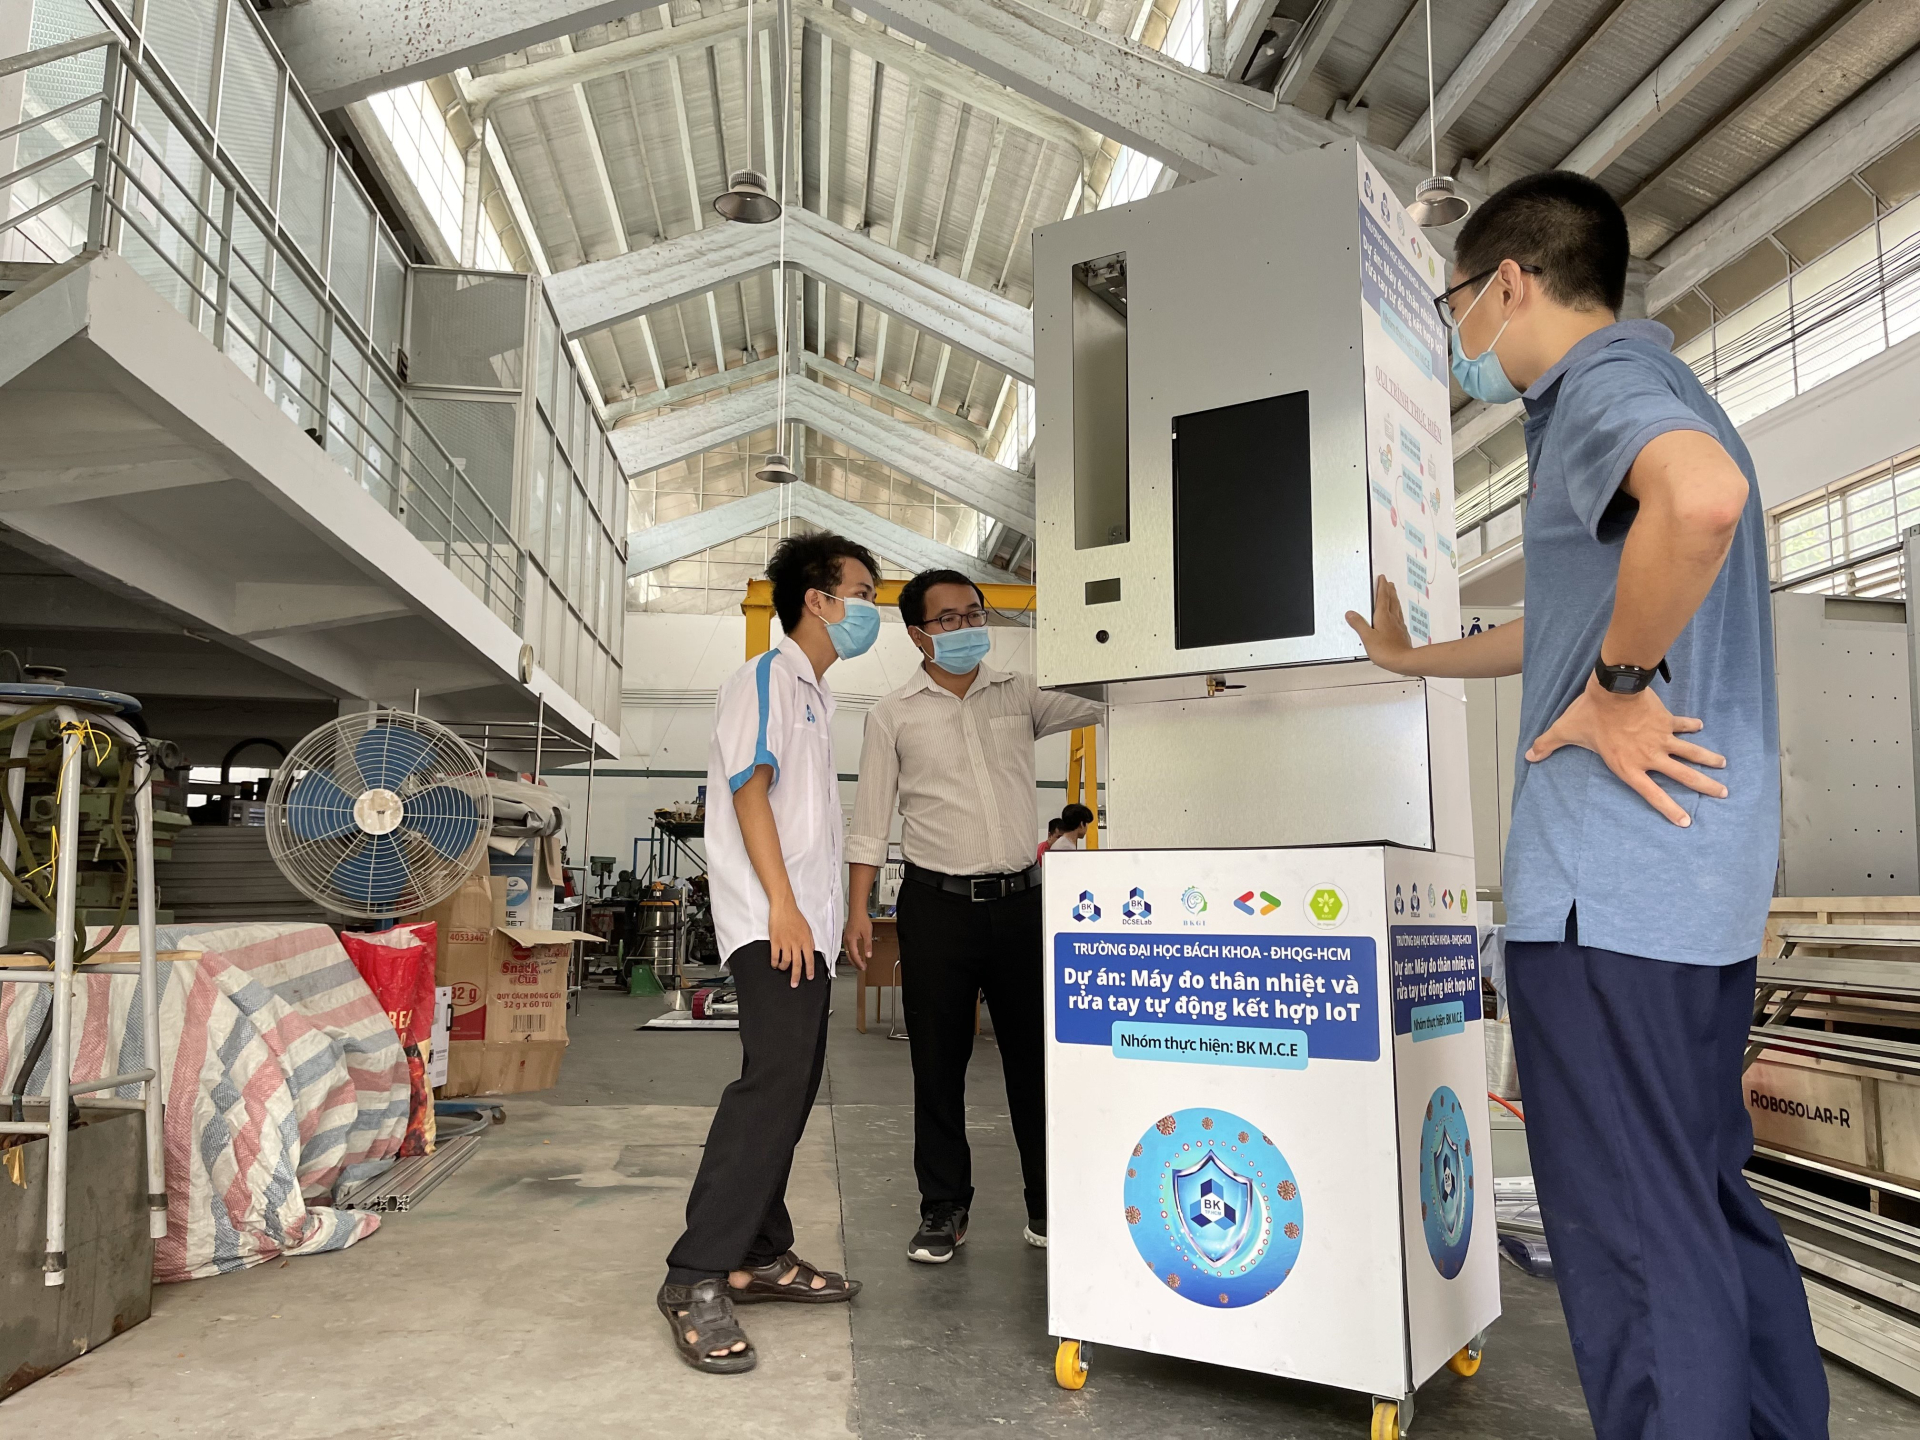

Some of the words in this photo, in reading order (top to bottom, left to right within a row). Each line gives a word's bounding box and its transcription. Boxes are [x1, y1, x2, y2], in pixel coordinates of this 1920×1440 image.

[1073, 940, 1127, 955] TRƯỜNG
[1129, 944, 1150, 959] ĐẠI
[1153, 944, 1181, 960] HỌC
[1183, 942, 1219, 958] BÁCH
[1222, 945, 1261, 959] KHOA
[1270, 946, 1351, 962] ĐHQG-HCM
[501, 960, 539, 974] Snack
[1394, 960, 1403, 980] Dự
[1404, 958, 1414, 975] án:
[1415, 957, 1428, 978] Máy
[1429, 957, 1437, 973] đo
[1437, 956, 1451, 972] thân
[1452, 955, 1467, 975] nhiệt
[1467, 955, 1475, 970] và
[1064, 967, 1093, 990] Dự
[1096, 967, 1126, 987] án:
[1131, 969, 1174, 993] Máy
[1178, 970, 1204, 989] đo
[1209, 970, 1260, 991] thân
[1266, 973, 1326, 998] nhiệt
[1331, 974, 1359, 994] và
[1397, 981, 1407, 1000] rửa
[1409, 984, 1418, 1002] tay
[1420, 982, 1427, 1001] tự
[1429, 979, 1443, 999] động
[1444, 977, 1454, 994] kết
[1455, 977, 1466, 996] hợp
[503, 1001, 514, 1009] 32
[1068, 989, 1103, 1010] rửa
[1107, 994, 1141, 1017] tay
[1145, 996, 1171, 1018] tự
[1174, 995, 1227, 1021] động
[1232, 997, 1269, 1018] kết
[1274, 999, 1319, 1025] hợp
[1325, 1002, 1361, 1022] IoT
[1121, 1033, 1162, 1049] Nhóm
[1164, 1036, 1197, 1054] thực
[1199, 1038, 1234, 1055] hiện:
[1236, 1040, 1256, 1055] BK
[1259, 1042, 1298, 1057] M.C.E
[1204, 1198, 1221, 1210] BK
